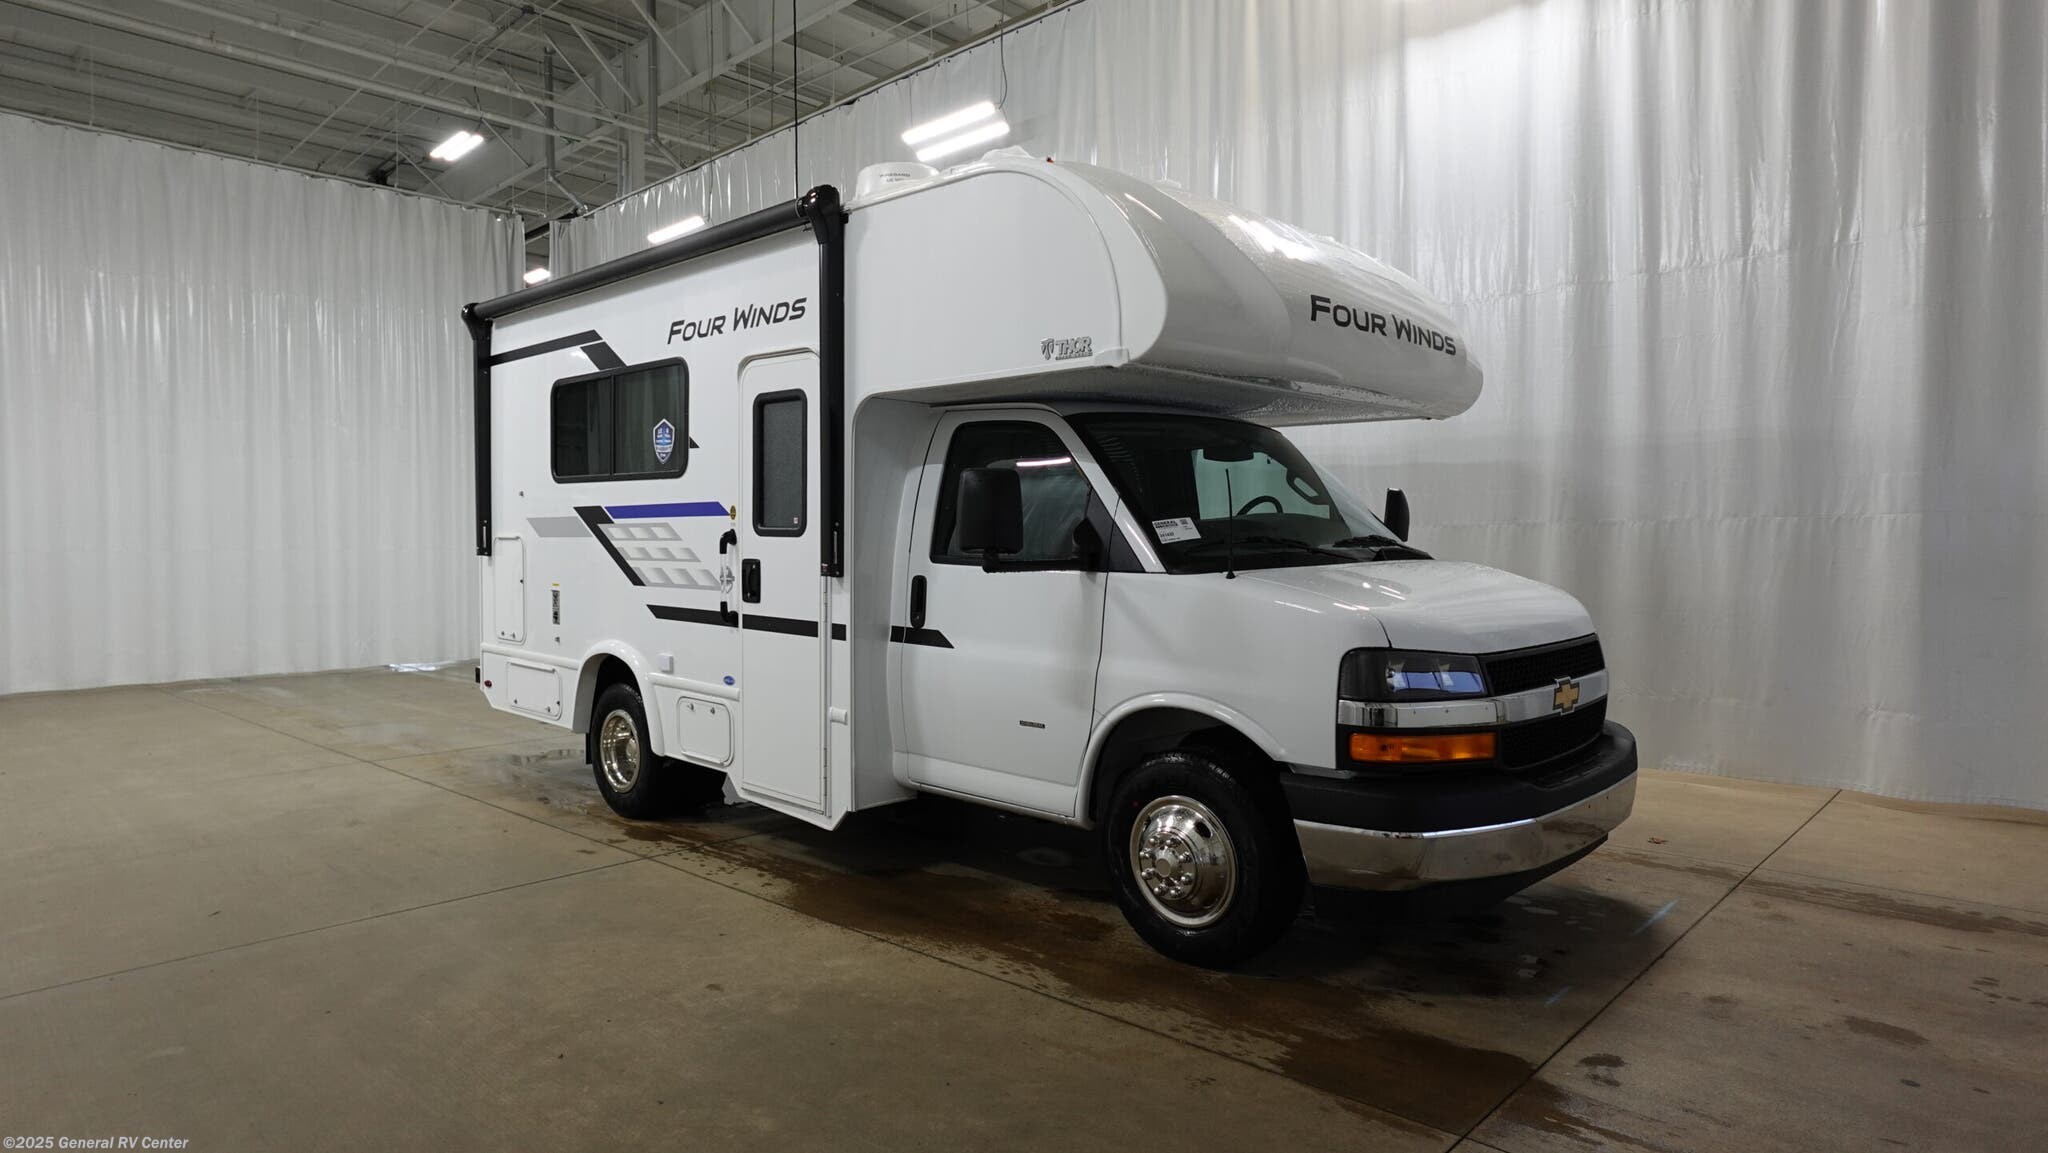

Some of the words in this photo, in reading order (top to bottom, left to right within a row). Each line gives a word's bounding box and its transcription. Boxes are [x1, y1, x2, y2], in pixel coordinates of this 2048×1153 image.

[667, 315, 726, 344] FOUR
[733, 297, 807, 331] WINDS
[1310, 294, 1387, 336] FOUR
[1391, 314, 1456, 356] WINDS
[1055, 336, 1092, 355] THOR
